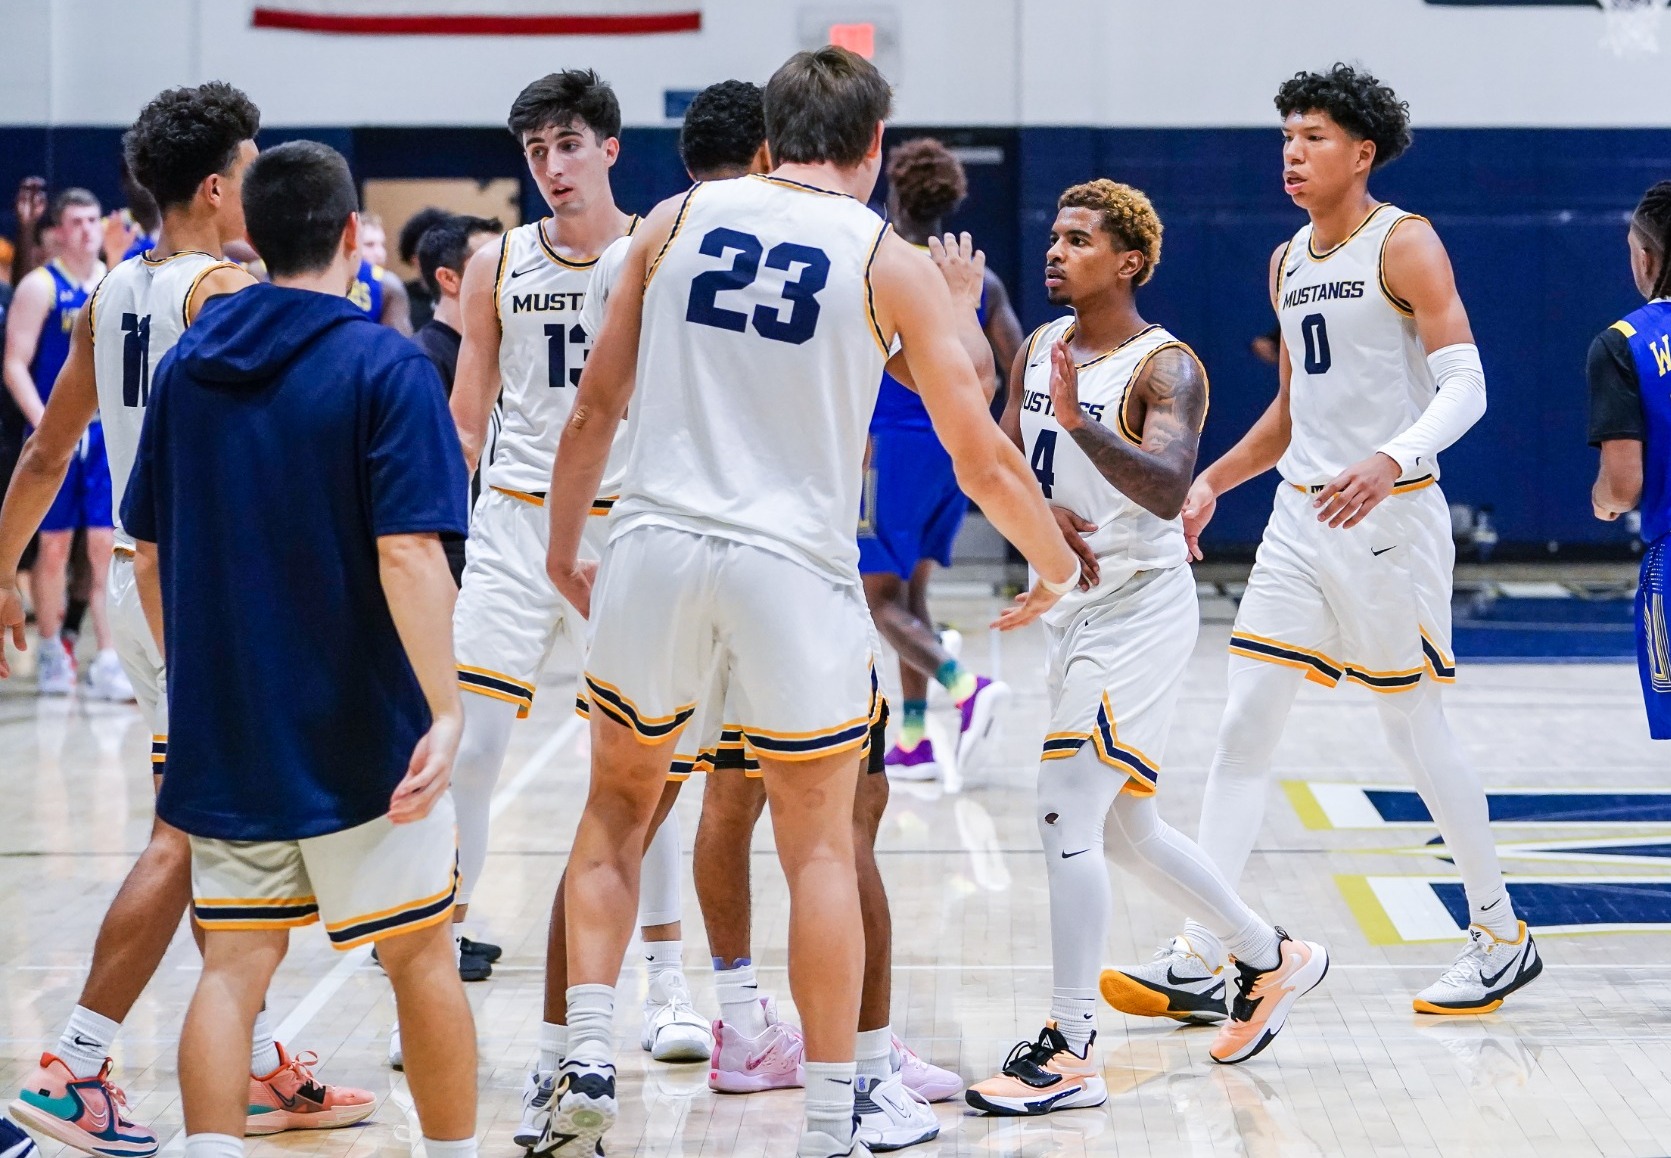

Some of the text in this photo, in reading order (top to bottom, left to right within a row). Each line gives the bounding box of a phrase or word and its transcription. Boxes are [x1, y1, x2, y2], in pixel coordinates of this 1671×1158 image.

[513, 293, 584, 313] MUST
[686, 227, 831, 345] 23
[1282, 281, 1364, 310] MUSTANGS
[1301, 313, 1331, 375] 0
[1031, 429, 1058, 499] 4
